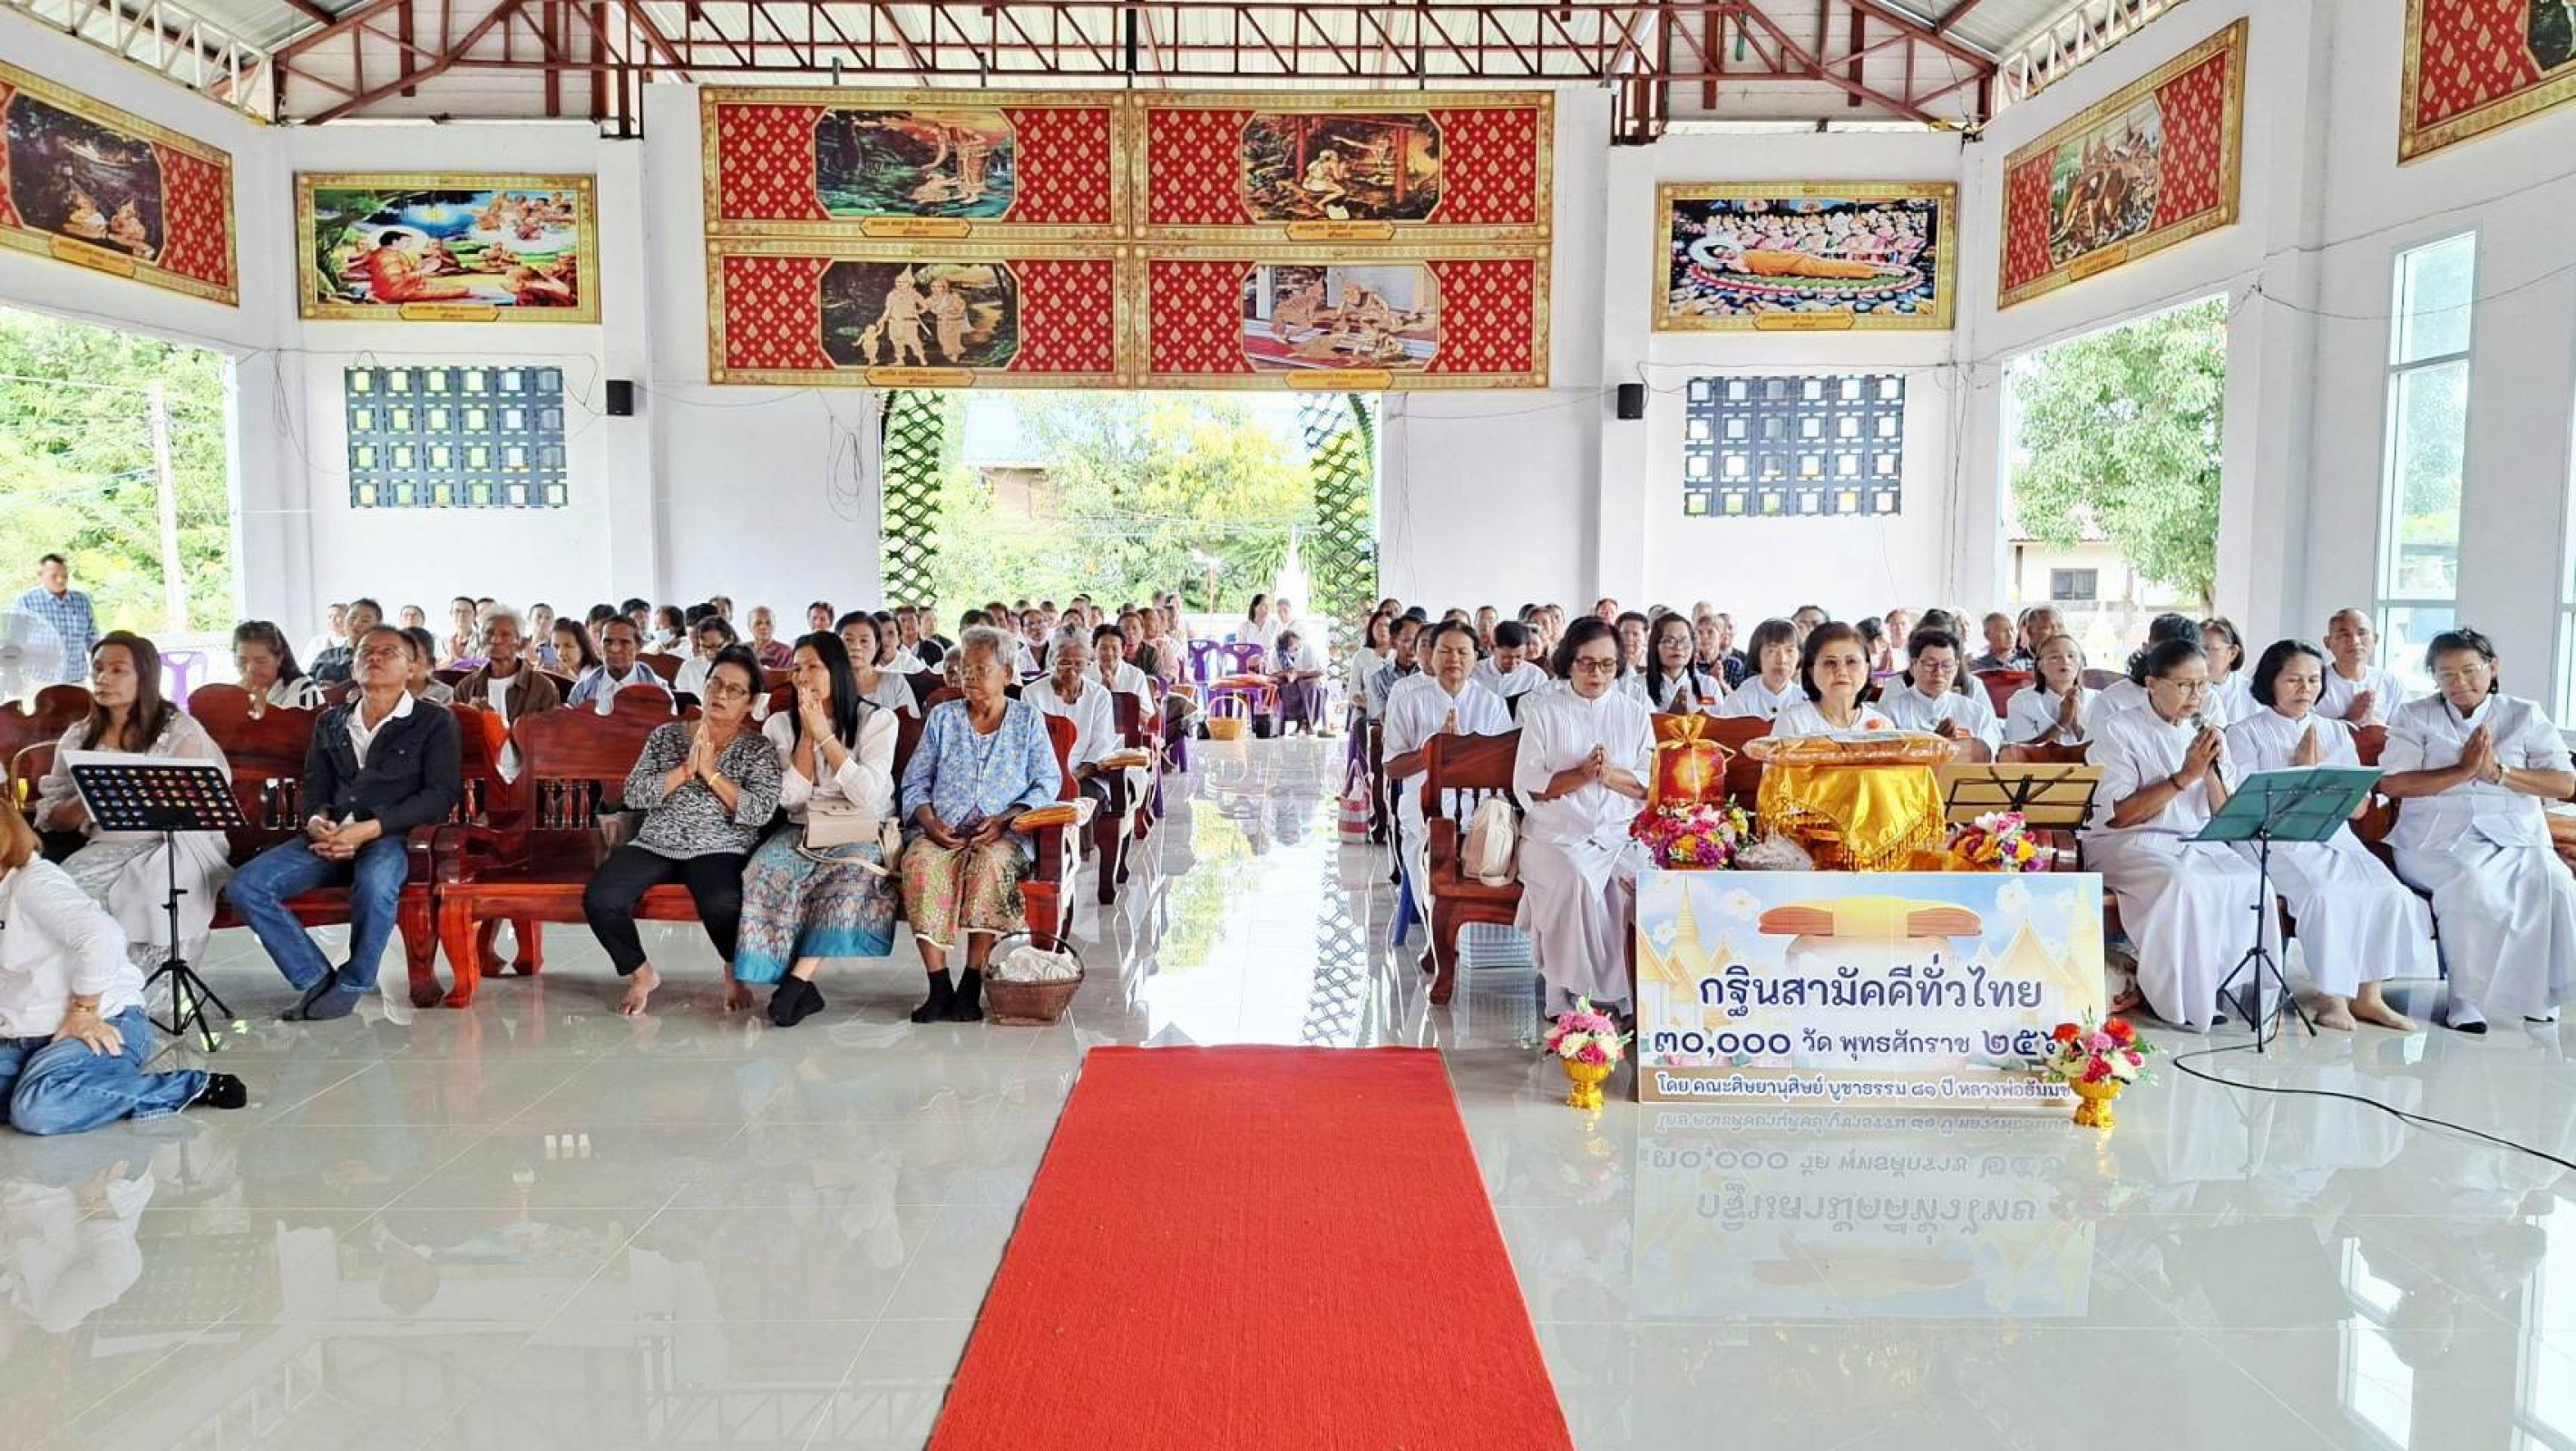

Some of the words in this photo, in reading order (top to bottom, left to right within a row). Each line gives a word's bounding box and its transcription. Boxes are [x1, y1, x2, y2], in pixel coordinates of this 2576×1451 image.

[1700, 953, 2042, 1017] กฐินสามัคคีทั่วไทย
[1654, 1031, 1791, 1057] ๓๐,๐๐๐
[1802, 1027, 1832, 1052] วัด
[1839, 1028, 1970, 1061] พุทธศักราช
[1983, 1029, 2055, 1056] ๒๕๖
[1657, 1074, 1688, 1092] โดย
[1693, 1076, 1824, 1099] คณะศิษยานุศิษย์
[1828, 1080, 1905, 1101] บูชาธรรม
[1941, 1078, 1953, 1096] ปี
